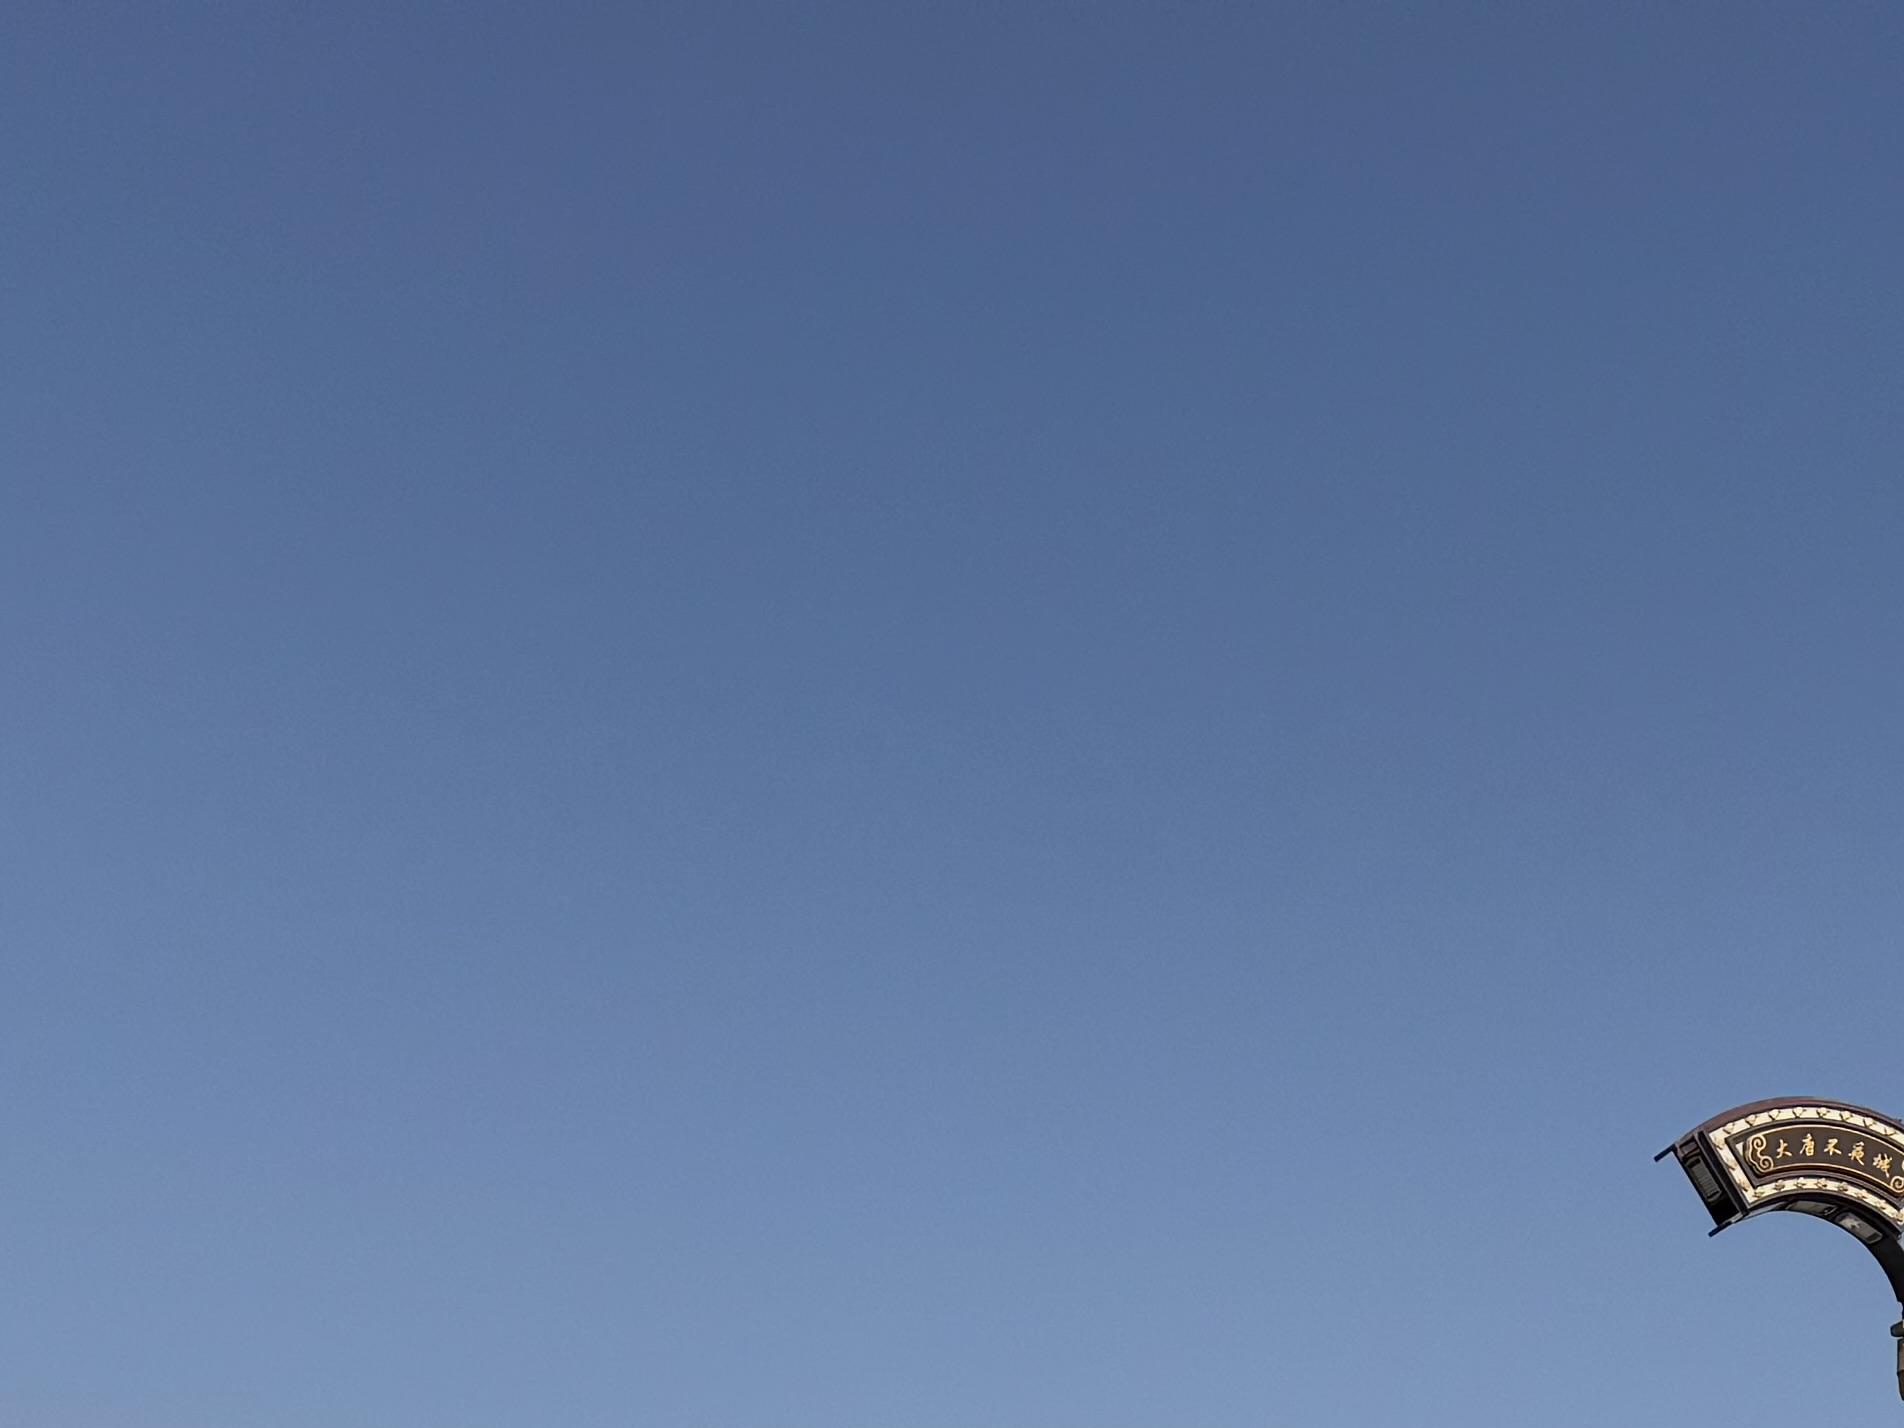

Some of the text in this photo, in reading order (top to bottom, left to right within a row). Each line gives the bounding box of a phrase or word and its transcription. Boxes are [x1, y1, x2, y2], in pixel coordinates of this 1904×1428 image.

[1776, 1133, 1893, 1178] 大唐不夜城
